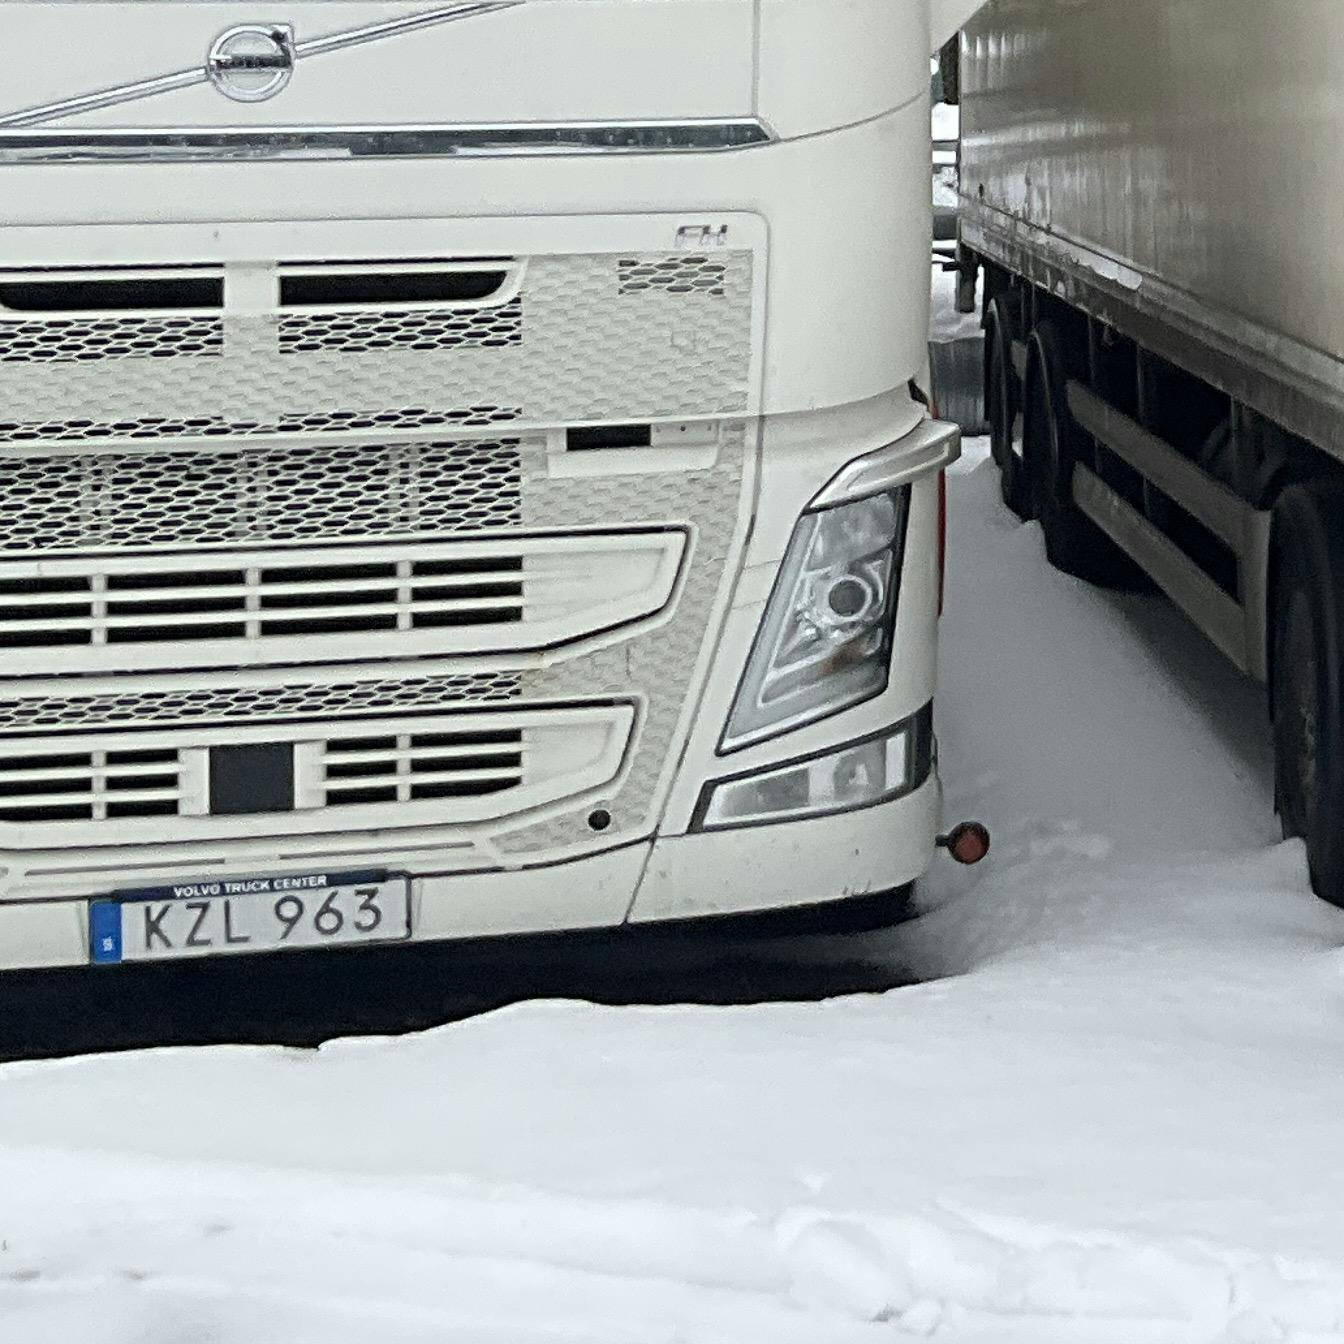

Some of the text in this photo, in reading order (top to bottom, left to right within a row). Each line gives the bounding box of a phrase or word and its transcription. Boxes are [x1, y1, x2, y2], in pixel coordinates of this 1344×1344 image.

[173, 874, 328, 899] VOLVO TRUCK CENTER
[144, 886, 383, 951] KZL 963
